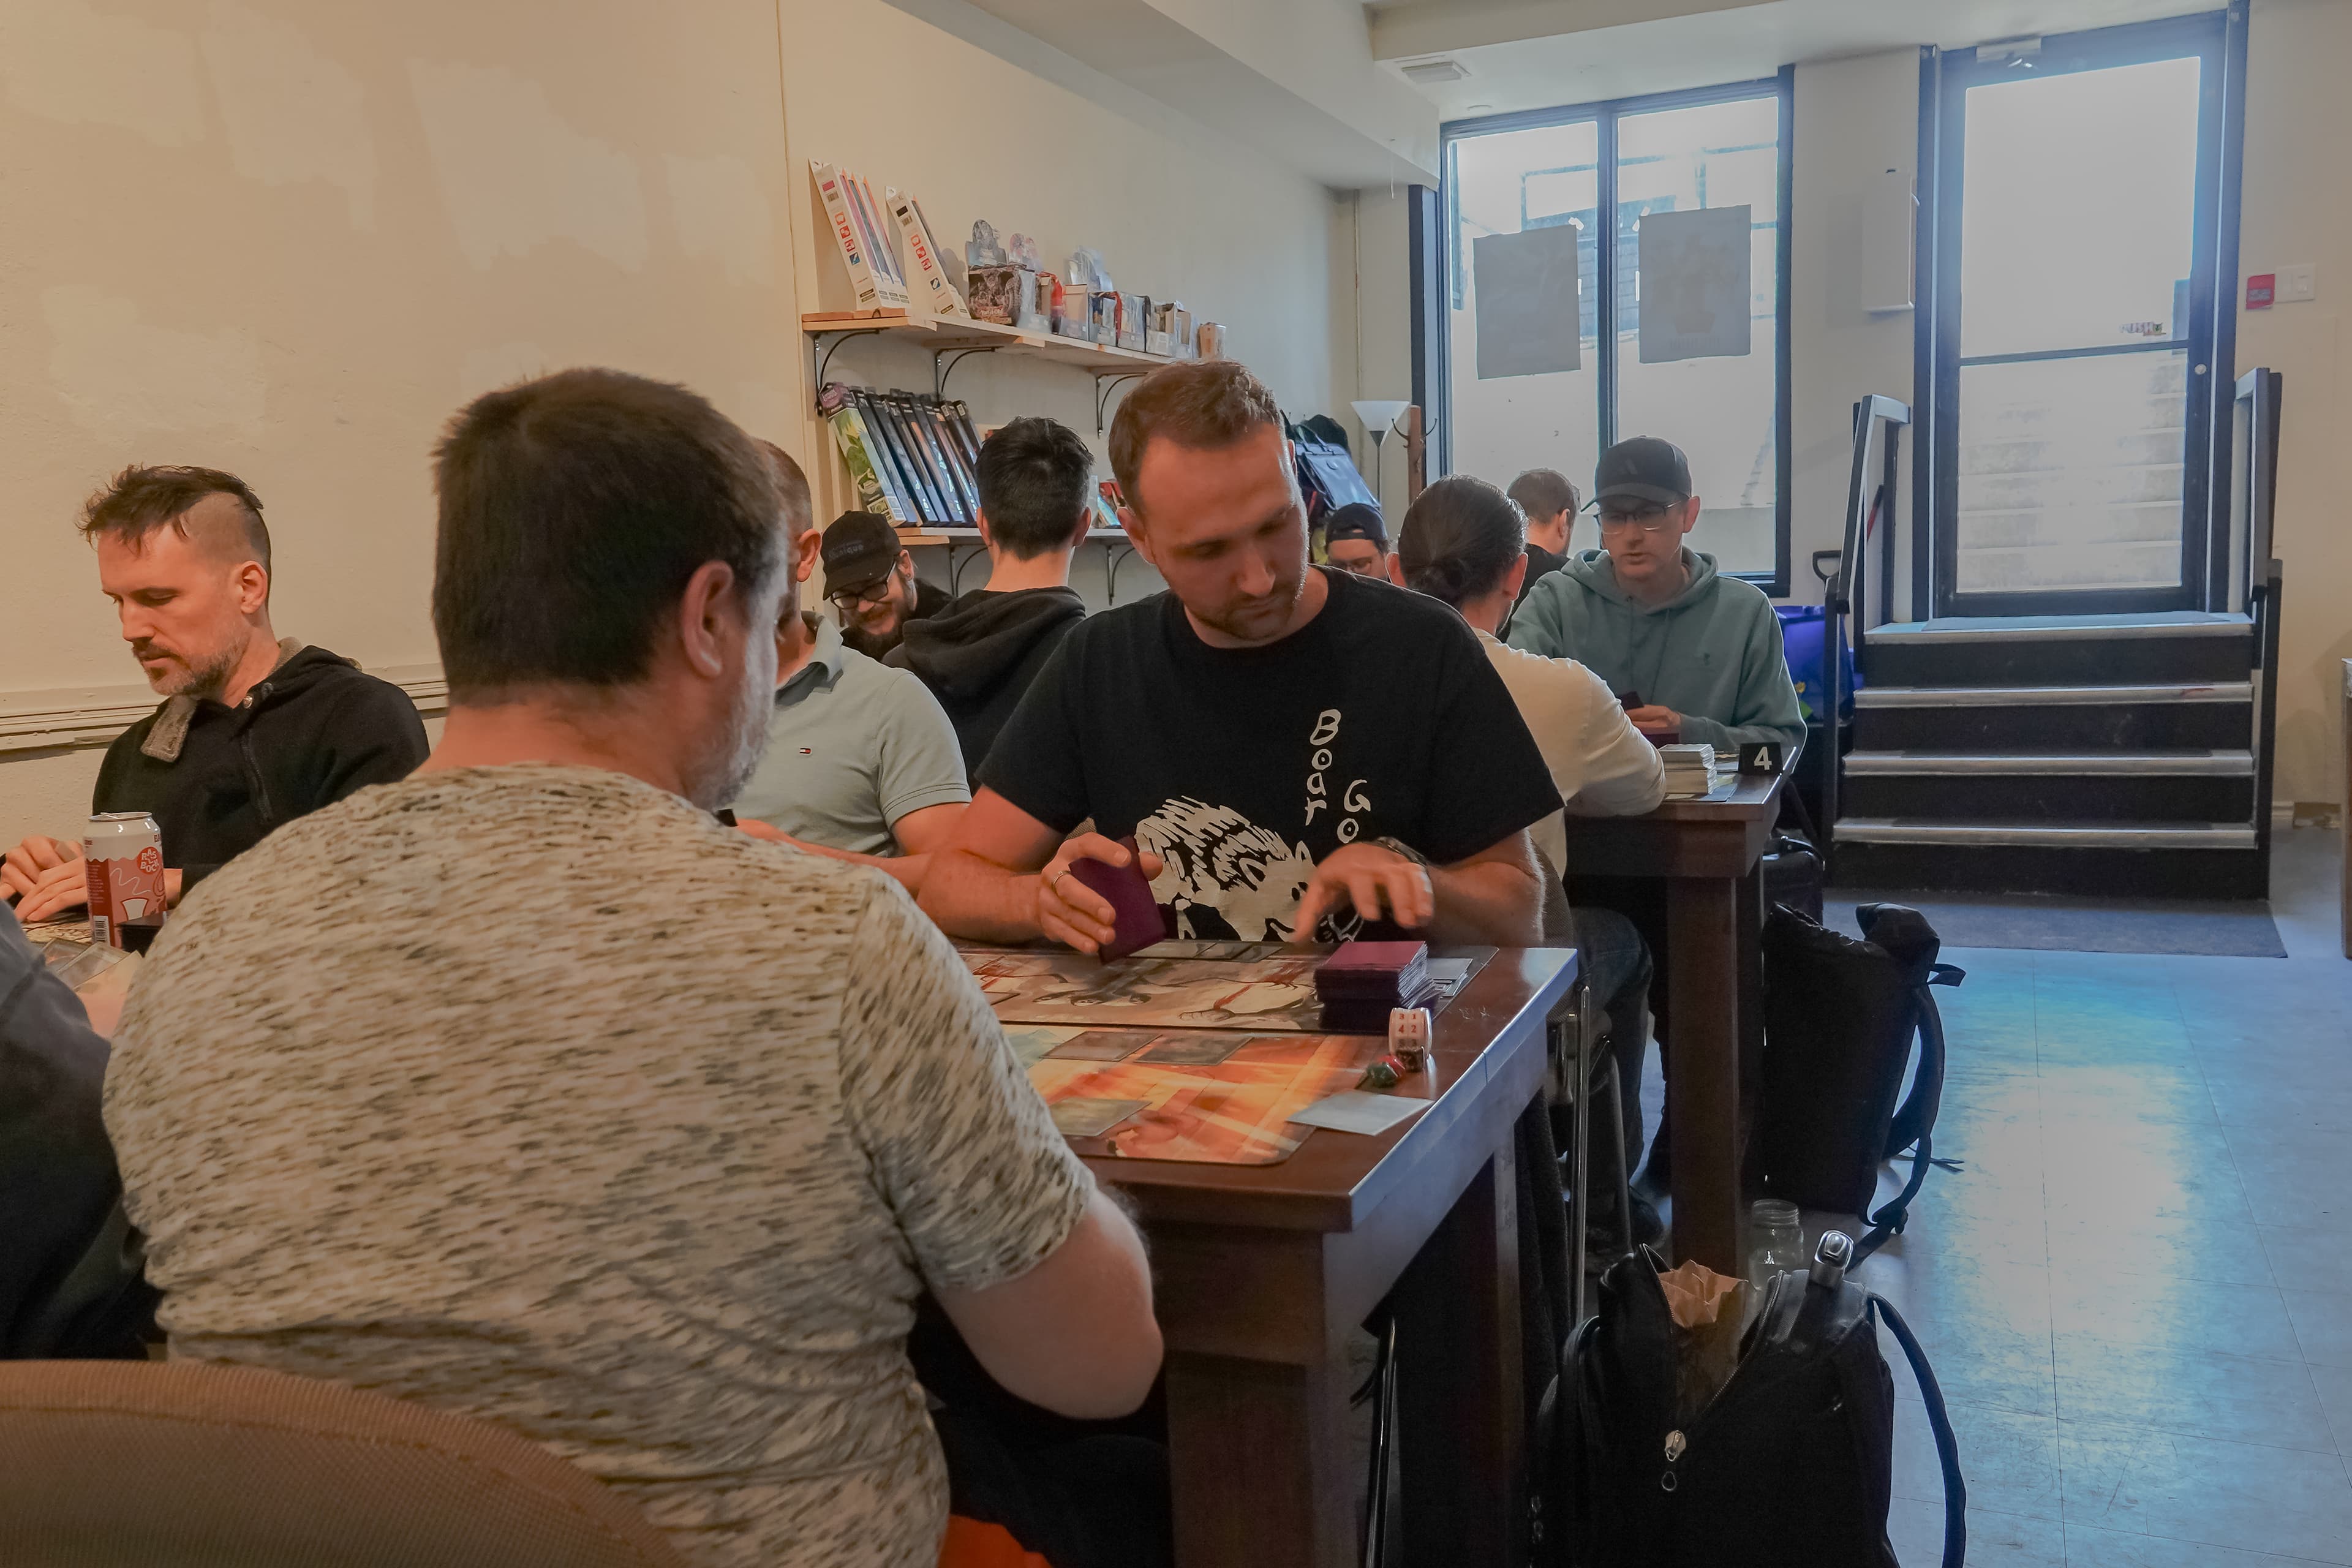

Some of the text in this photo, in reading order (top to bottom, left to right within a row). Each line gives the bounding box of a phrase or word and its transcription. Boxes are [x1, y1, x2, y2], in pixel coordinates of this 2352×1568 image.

[1305, 709, 1341, 826] Boar
[1754, 746, 1773, 770] 4
[1336, 779, 1371, 844] Go
[141, 848, 157, 861] RAS
[1398, 1024, 1417, 1033] 4 2
